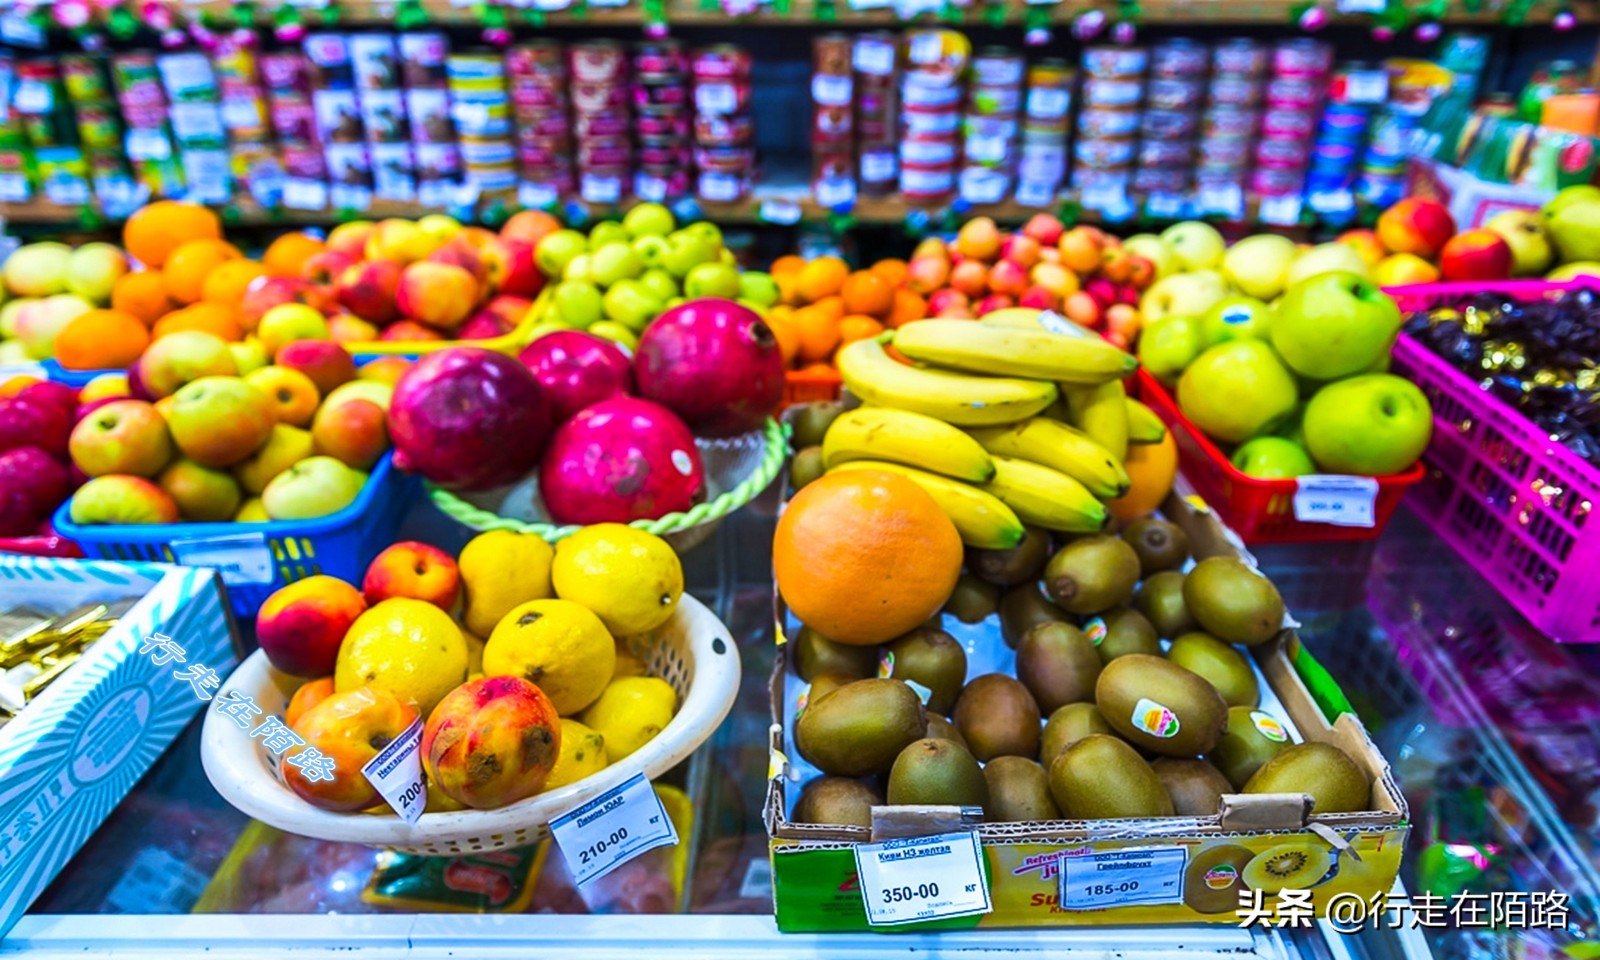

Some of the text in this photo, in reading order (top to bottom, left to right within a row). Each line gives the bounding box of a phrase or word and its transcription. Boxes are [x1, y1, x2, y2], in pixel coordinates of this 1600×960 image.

[577, 795, 625, 828] Лимон ЮАР
[649, 815, 660, 824] кг
[579, 827, 628, 864] 210-00
[878, 850, 902, 862] Киви
[1043, 864, 1059, 879] ju
[882, 882, 939, 903] 350-00
[965, 884, 977, 892] кг
[1084, 881, 1139, 896] 185-00
[1030, 893, 1059, 907] Su
